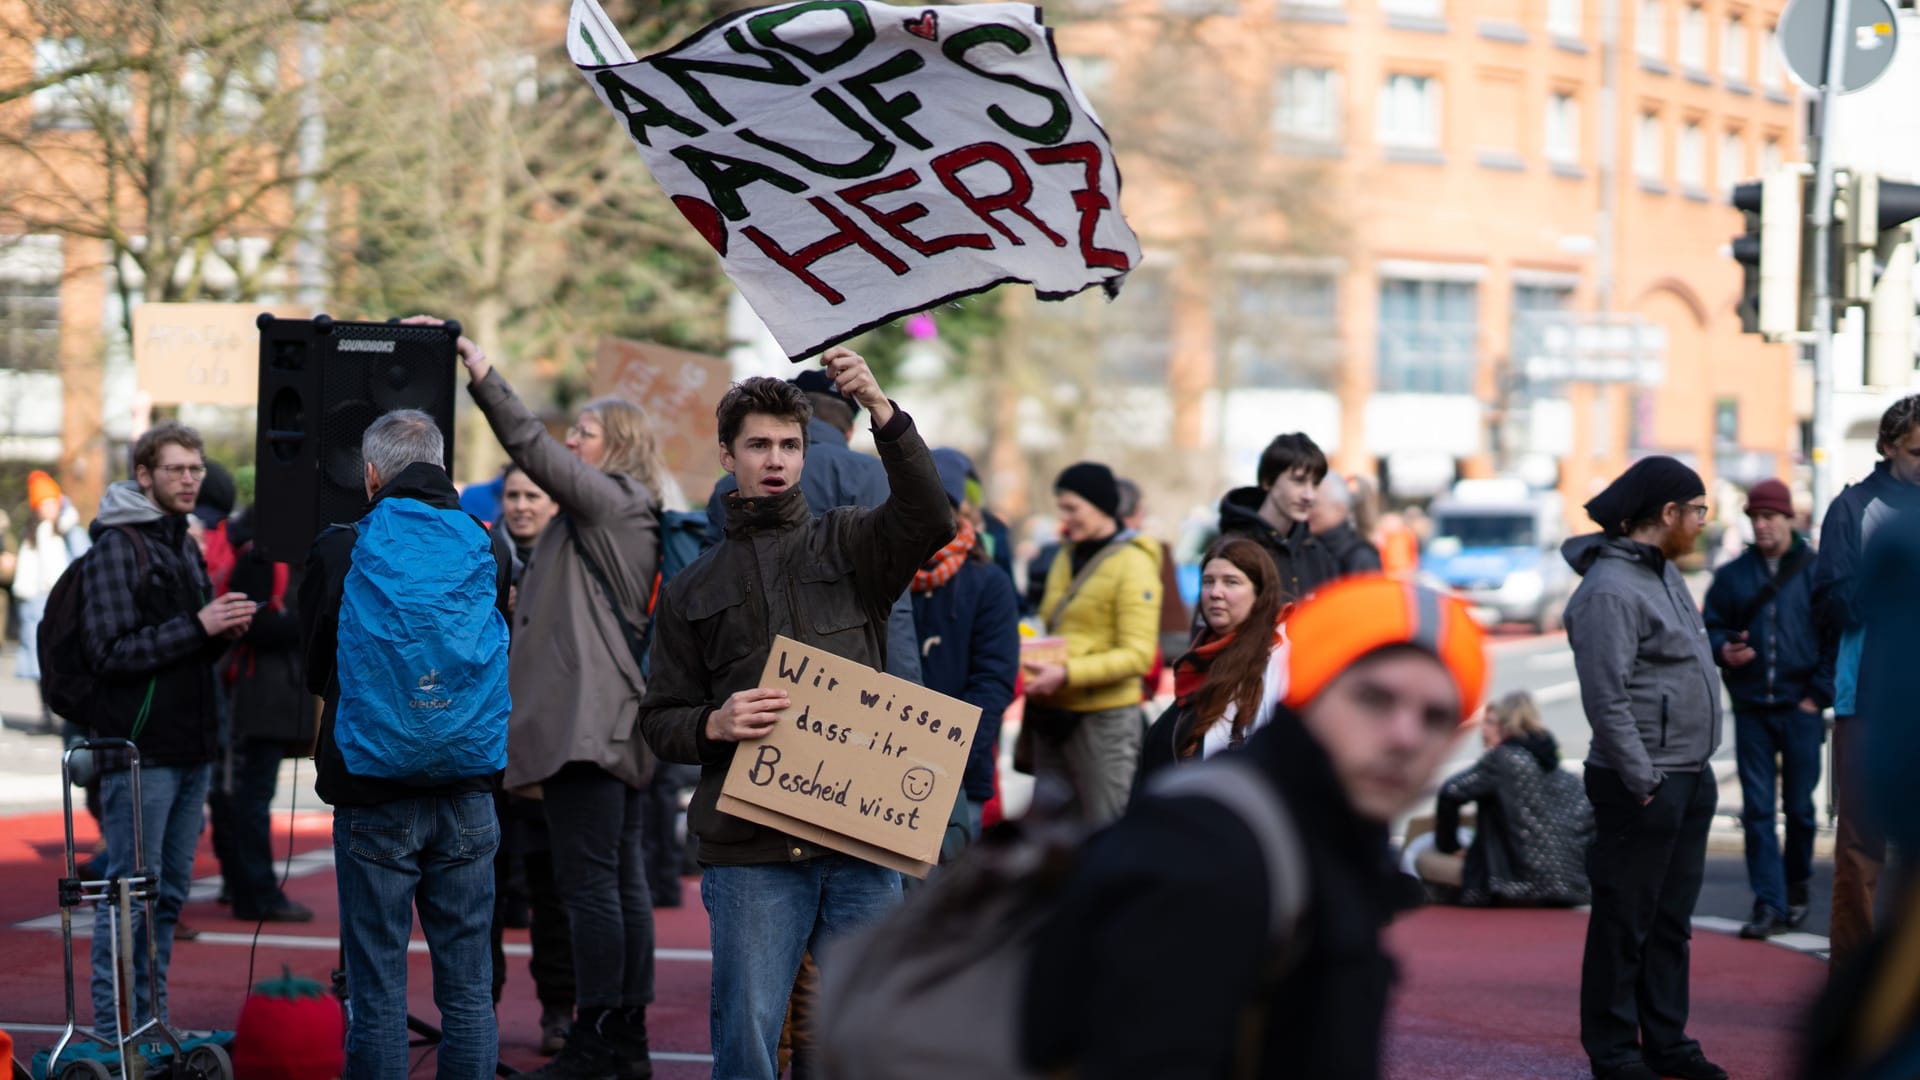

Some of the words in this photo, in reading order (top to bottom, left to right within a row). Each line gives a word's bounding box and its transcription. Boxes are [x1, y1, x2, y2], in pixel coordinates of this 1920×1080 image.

[580, 0, 876, 147] AND
[670, 23, 1072, 222] AUFS
[740, 140, 1130, 306] HERZ
[778, 650, 840, 692] Wir
[860, 689, 966, 748] wissen,
[796, 705, 852, 744] dass
[868, 731, 909, 759] ihr
[748, 744, 853, 808] Bescheid
[859, 796, 921, 831] wisst
